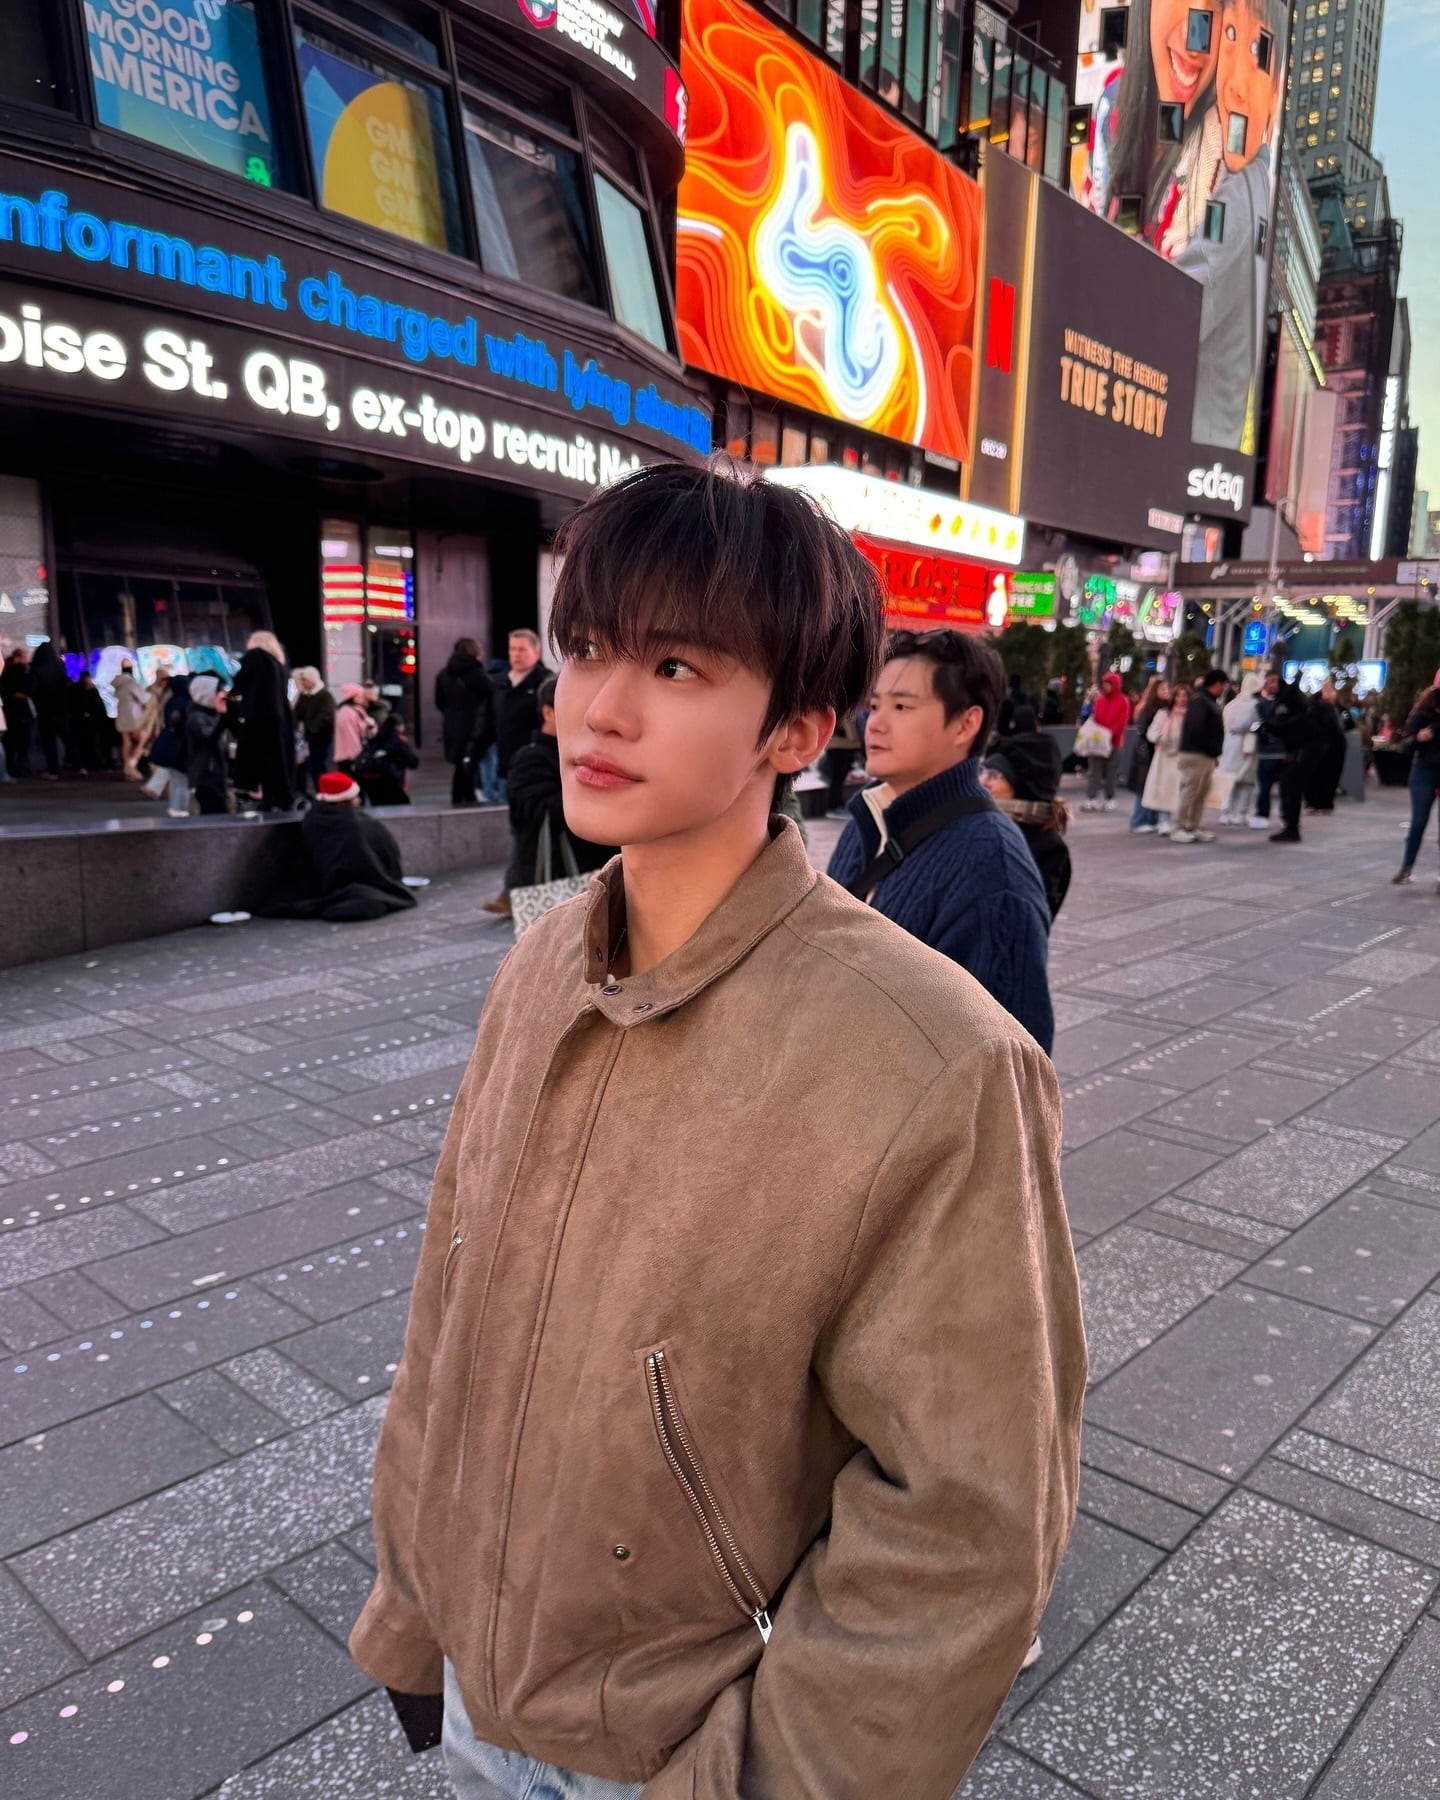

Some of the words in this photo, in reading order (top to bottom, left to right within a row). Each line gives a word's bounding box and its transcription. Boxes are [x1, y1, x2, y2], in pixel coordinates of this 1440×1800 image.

[84, 3, 240, 92] MORNING
[557, 15, 636, 81] FOOTBALL
[0, 190, 287, 310] nformant
[298, 270, 477, 366] charged
[484, 333, 557, 391] with
[563, 350, 631, 426] lying
[635, 384, 690, 445] about
[1060, 355, 1109, 416] TRUE
[1111, 379, 1168, 438] STORY
[1064, 327, 1112, 370] WITNESS
[1112, 351, 1134, 380] THE
[1133, 360, 1168, 395] HEROIC
[143, 329, 228, 400] St.
[244, 352, 341, 432] QB,
[352, 388, 486, 463] ex-top
[493, 420, 597, 485] recruit
[1187, 462, 1245, 511] sdaq
